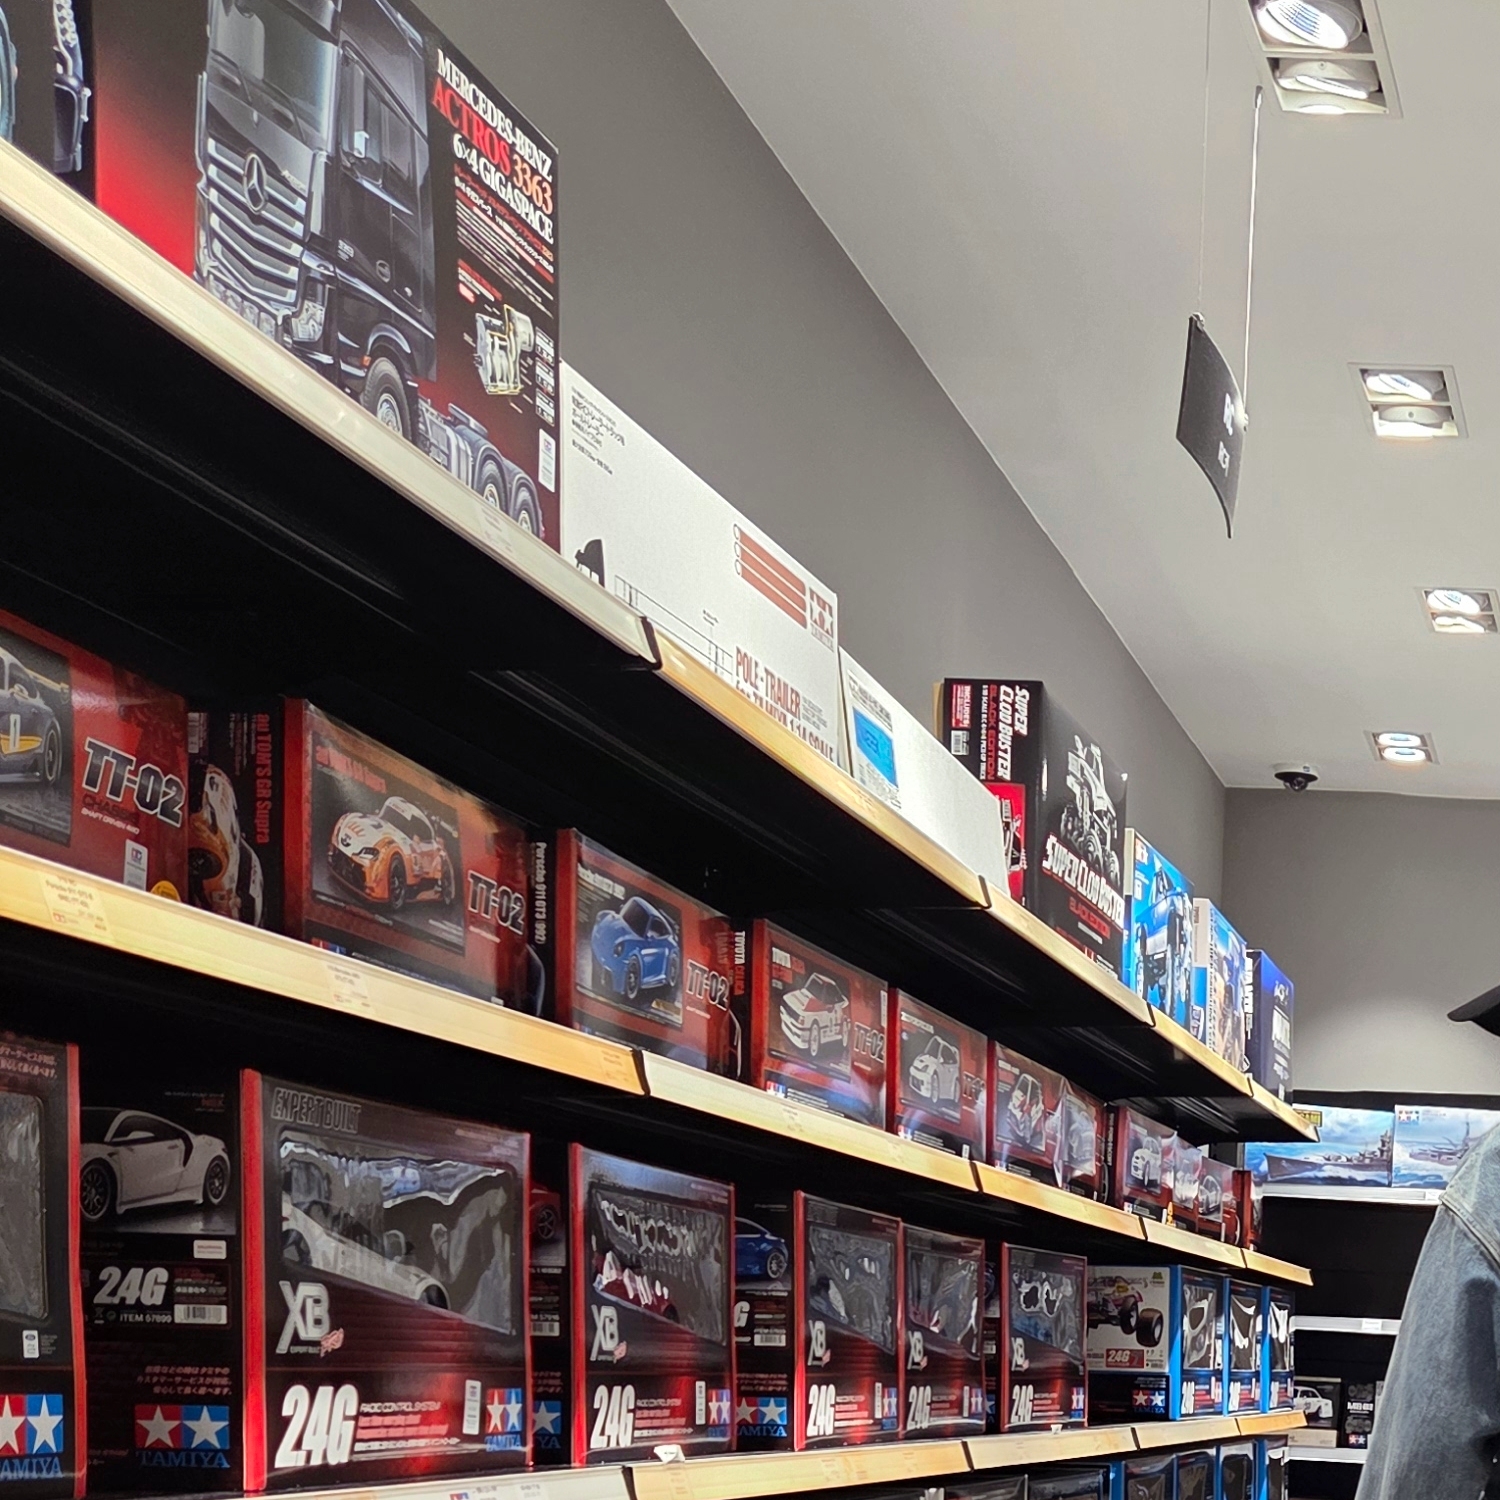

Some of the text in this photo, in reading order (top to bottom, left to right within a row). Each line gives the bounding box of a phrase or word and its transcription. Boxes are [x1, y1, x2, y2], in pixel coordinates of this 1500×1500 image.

[437, 48, 552, 182] MERCEDES-BENZ
[432, 77, 553, 214] ACTROS 3363
[479, 157, 554, 245] GIGASPACE
[1013, 685, 1030, 736] SUPER
[997, 721, 1014, 781] BUSTER
[82, 737, 185, 828] TT-02
[255, 800, 272, 844] Supra
[1042, 834, 1080, 889] SUPER
[467, 870, 526, 935] TT-02
[734, 931, 746, 964] TOYOTA
[686, 958, 730, 1011] TT-02
[276, 1280, 330, 1355] XB
[590, 1304, 618, 1361] XB
[808, 1320, 826, 1365] XB
[907, 1330, 924, 1370] XB
[135, 1450, 230, 1468] TAMIYA
